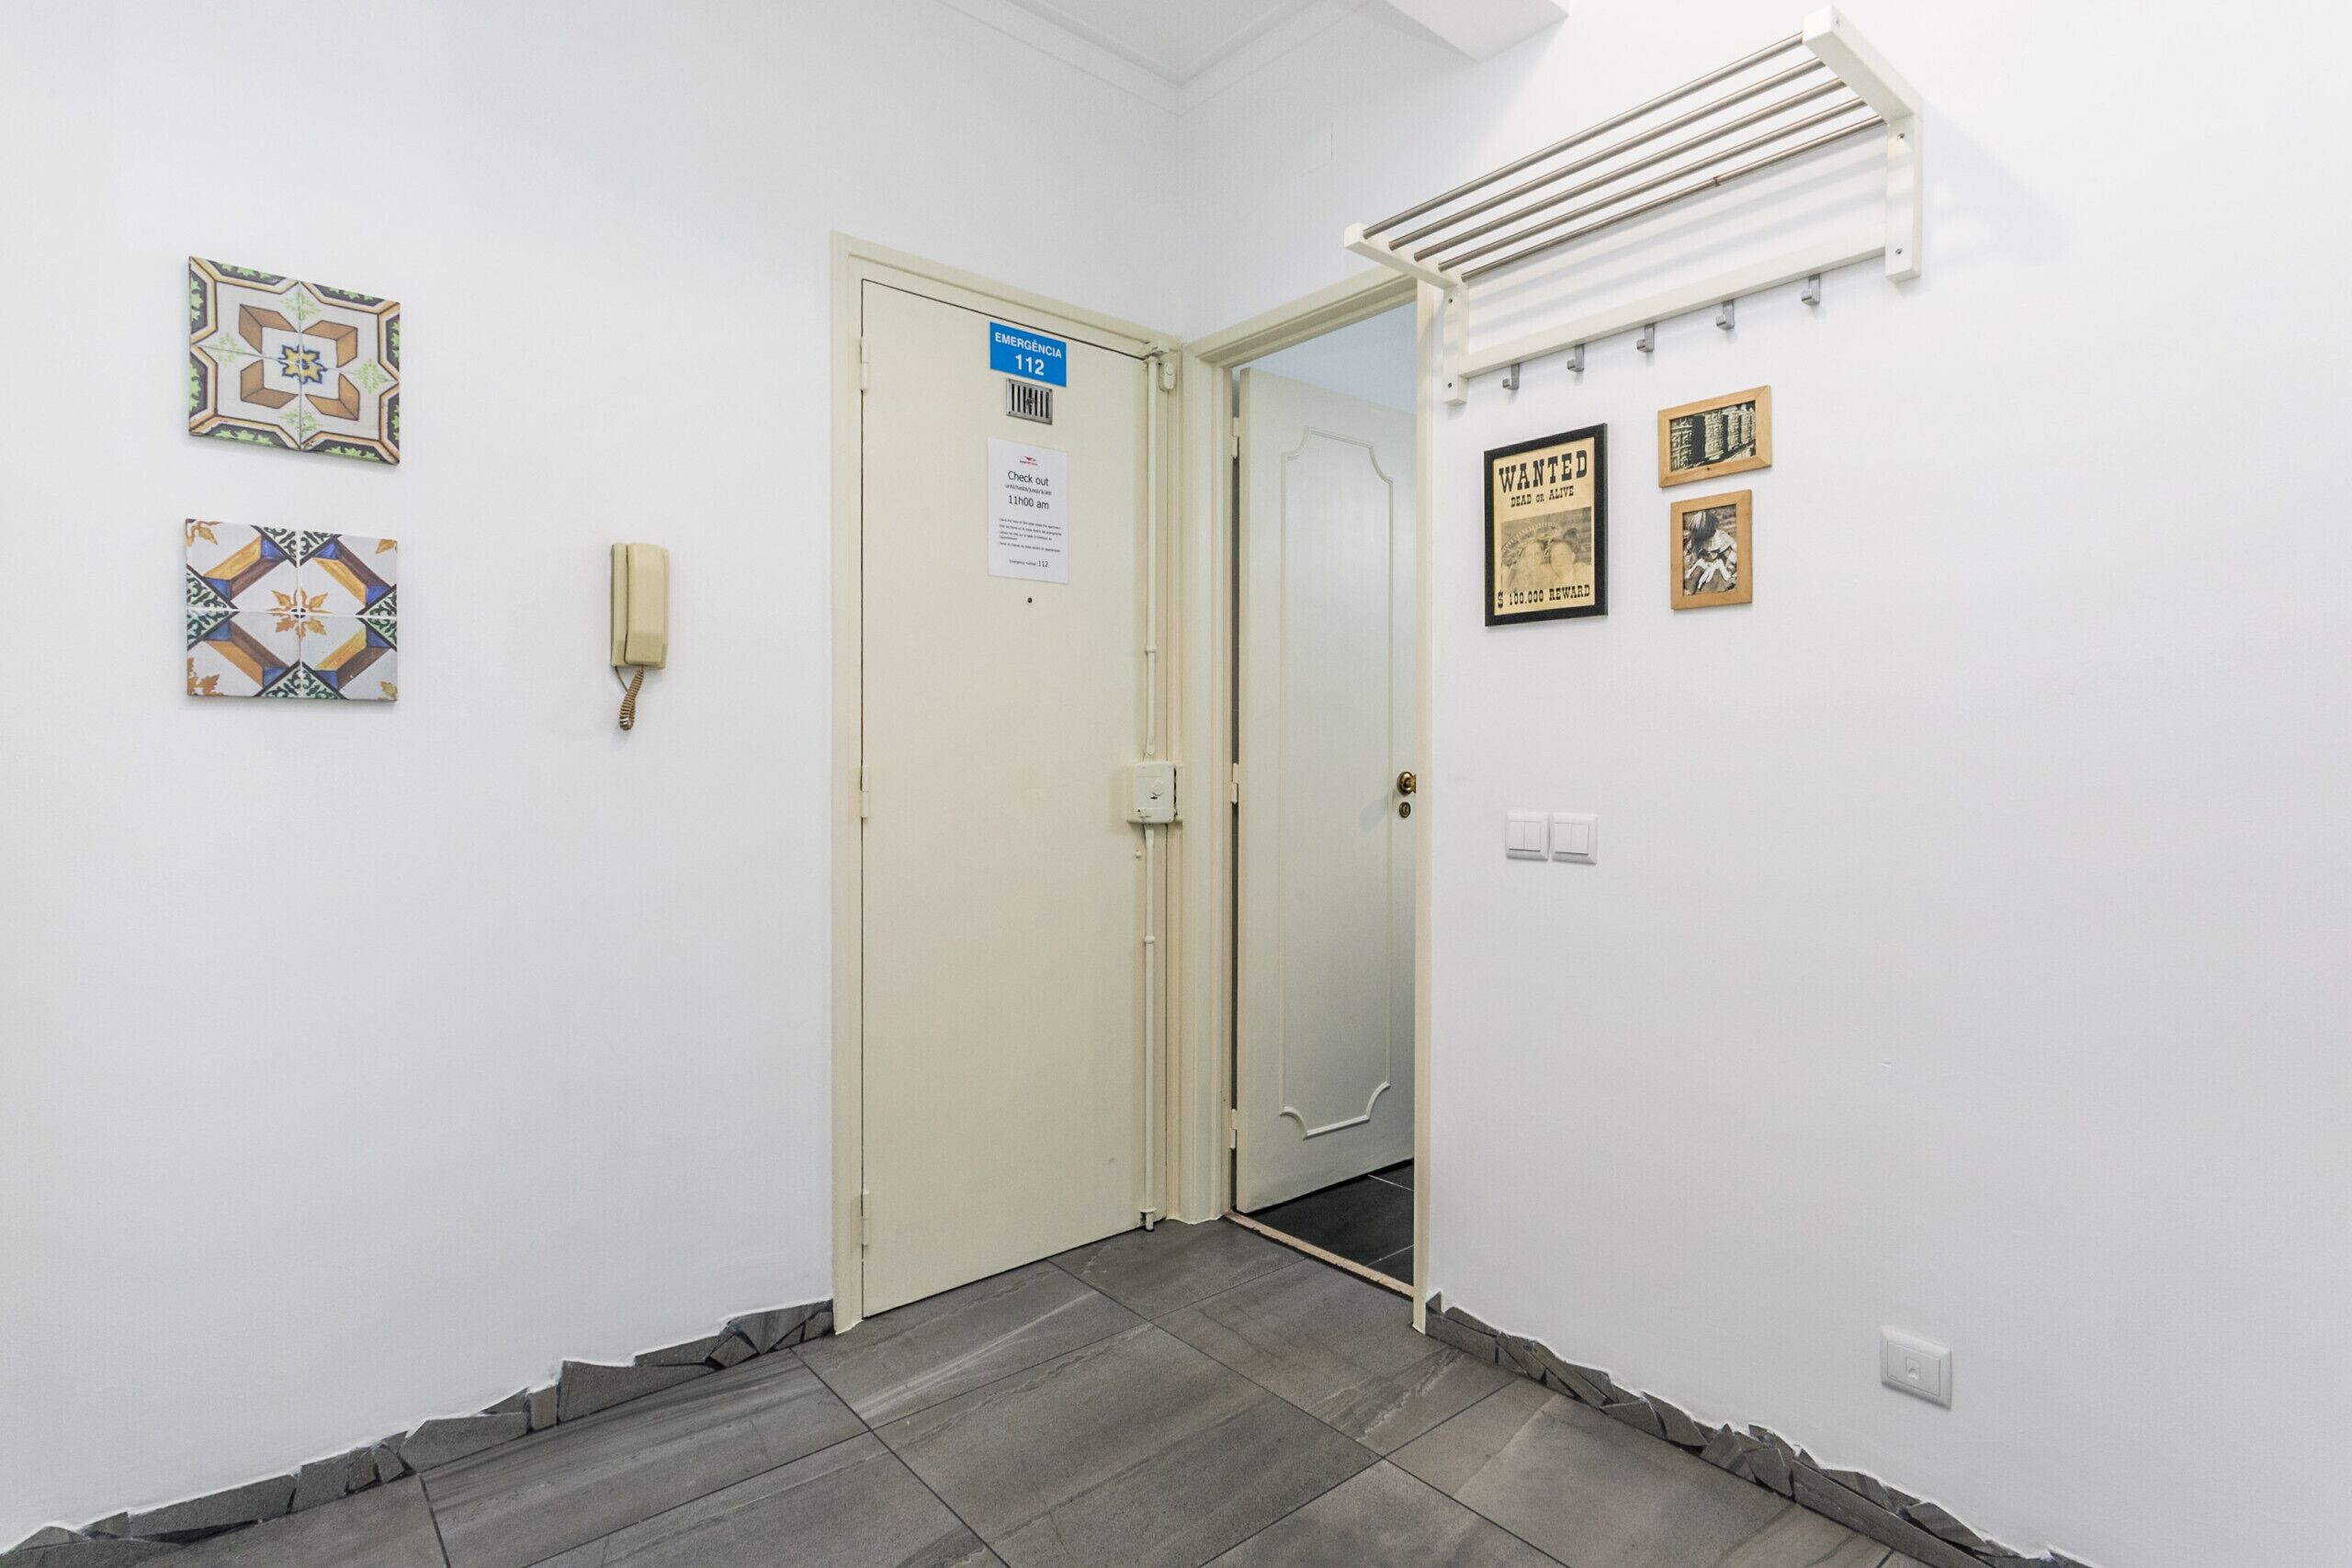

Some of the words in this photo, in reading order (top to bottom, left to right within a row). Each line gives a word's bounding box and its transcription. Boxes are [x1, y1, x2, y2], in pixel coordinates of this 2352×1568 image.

[994, 332, 1062, 358] EMERGÊNCIA
[1015, 354, 1045, 376] 112
[1007, 470, 1034, 483] Check
[1035, 477, 1049, 487] out
[1498, 449, 1588, 493] WANTED
[1008, 494, 1035, 508] 11h00
[1036, 500, 1049, 510] am
[1510, 493, 1532, 507] DEAD
[1548, 485, 1574, 501] ALIVE
[1510, 590, 1544, 606] 100.000
[1549, 584, 1590, 602] REWARD
